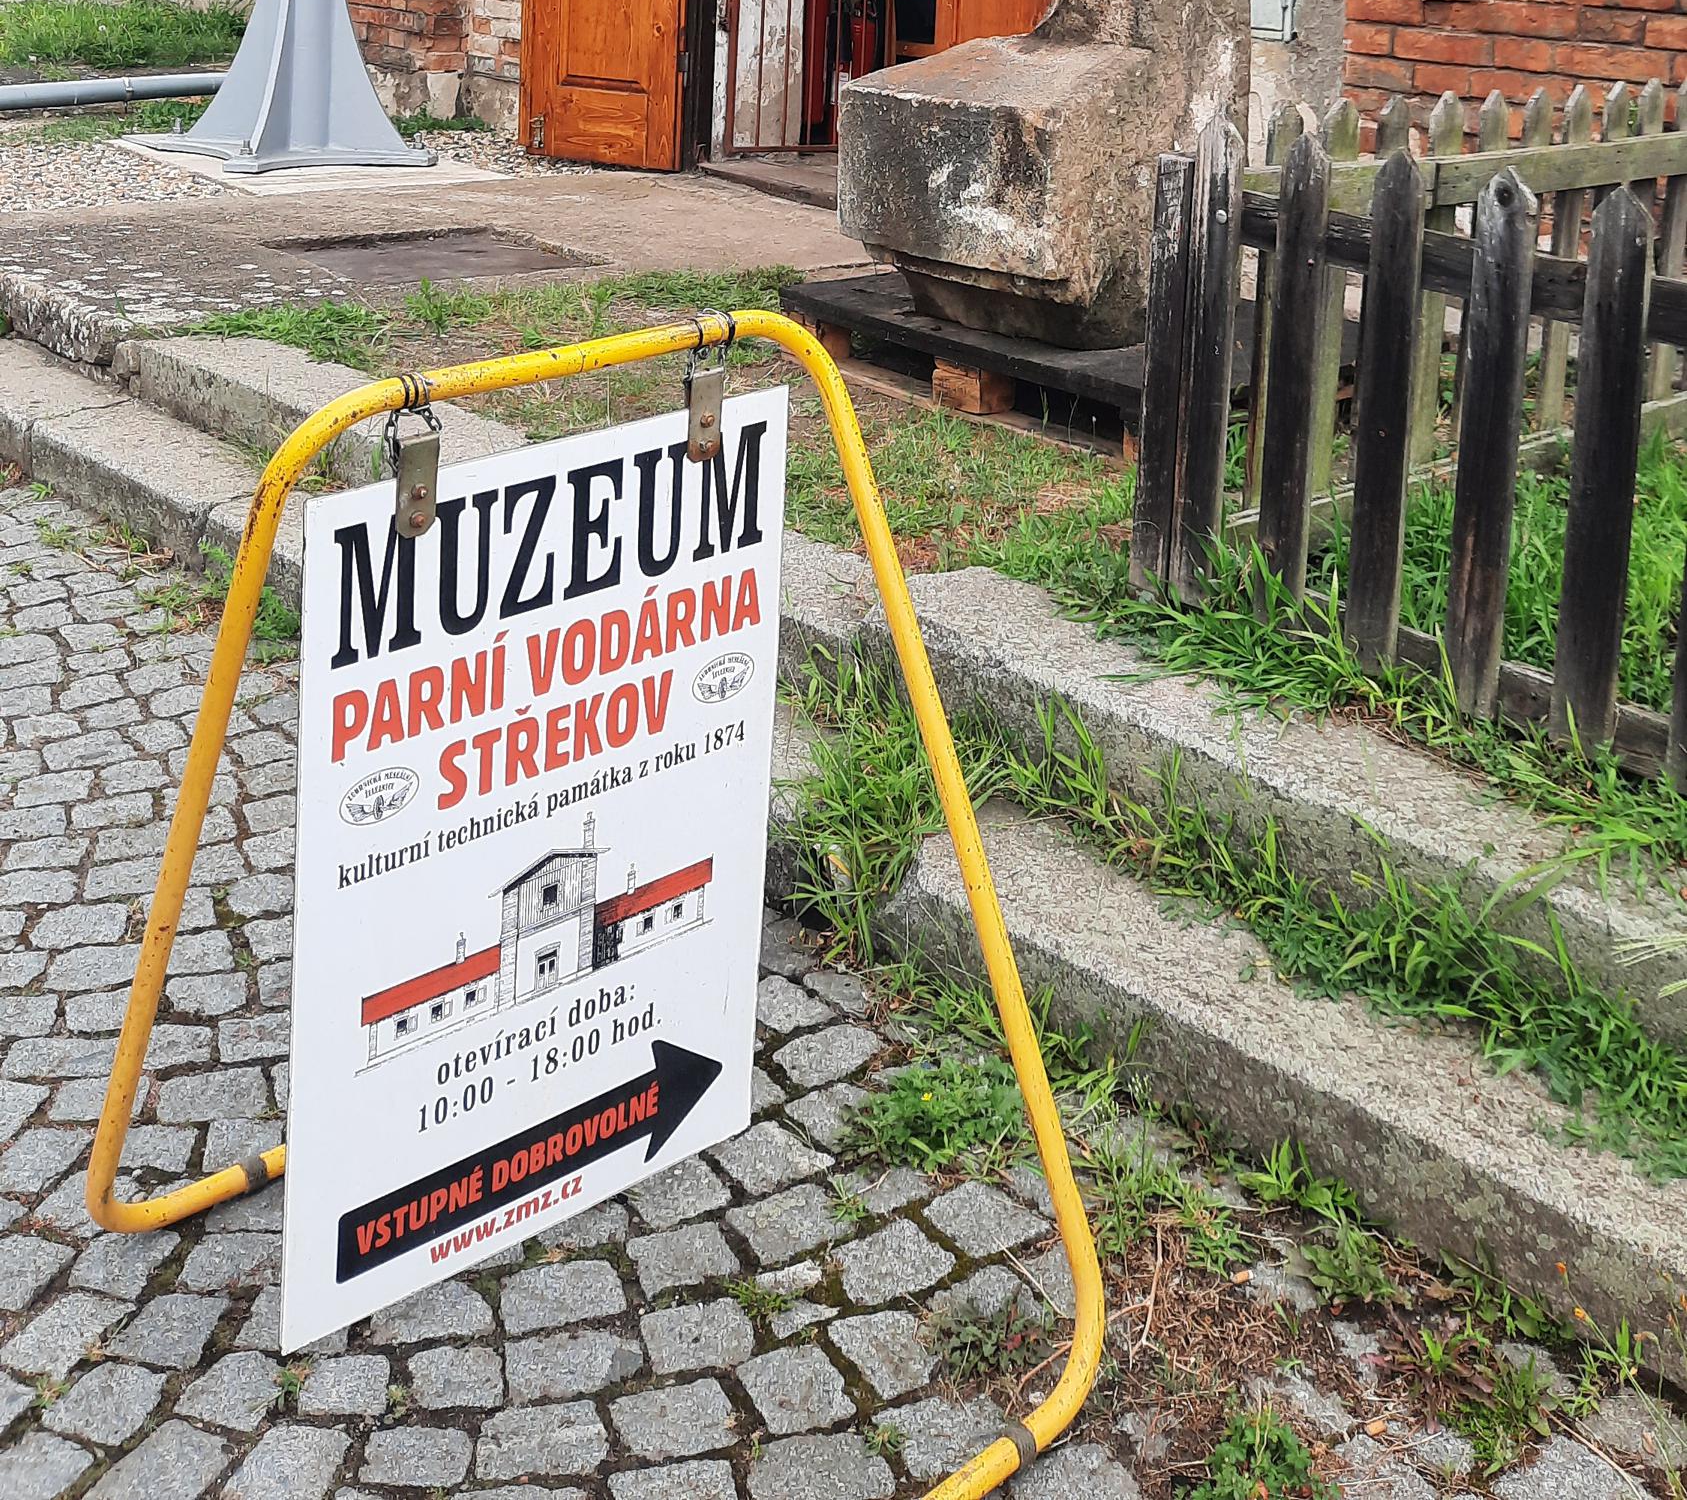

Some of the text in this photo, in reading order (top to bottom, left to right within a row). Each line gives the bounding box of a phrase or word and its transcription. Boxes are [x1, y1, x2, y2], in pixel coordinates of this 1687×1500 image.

[330, 420, 768, 670] MUZEUM
[330, 566, 762, 763] PARNÍ VODÁRNA
[437, 668, 675, 811] STŘEKOV
[337, 719, 745, 890] kulturní technická památka z roku 1874
[417, 1076, 495, 1134] 10:00
[530, 1027, 601, 1084] 18:00
[611, 1002, 662, 1047] hod.
[436, 982, 635, 1086] otevírací doba:
[355, 1080, 659, 1256] VSTUPNÉ DOBROVOLNÉ
[429, 1172, 584, 1264] www.zmz.cz
